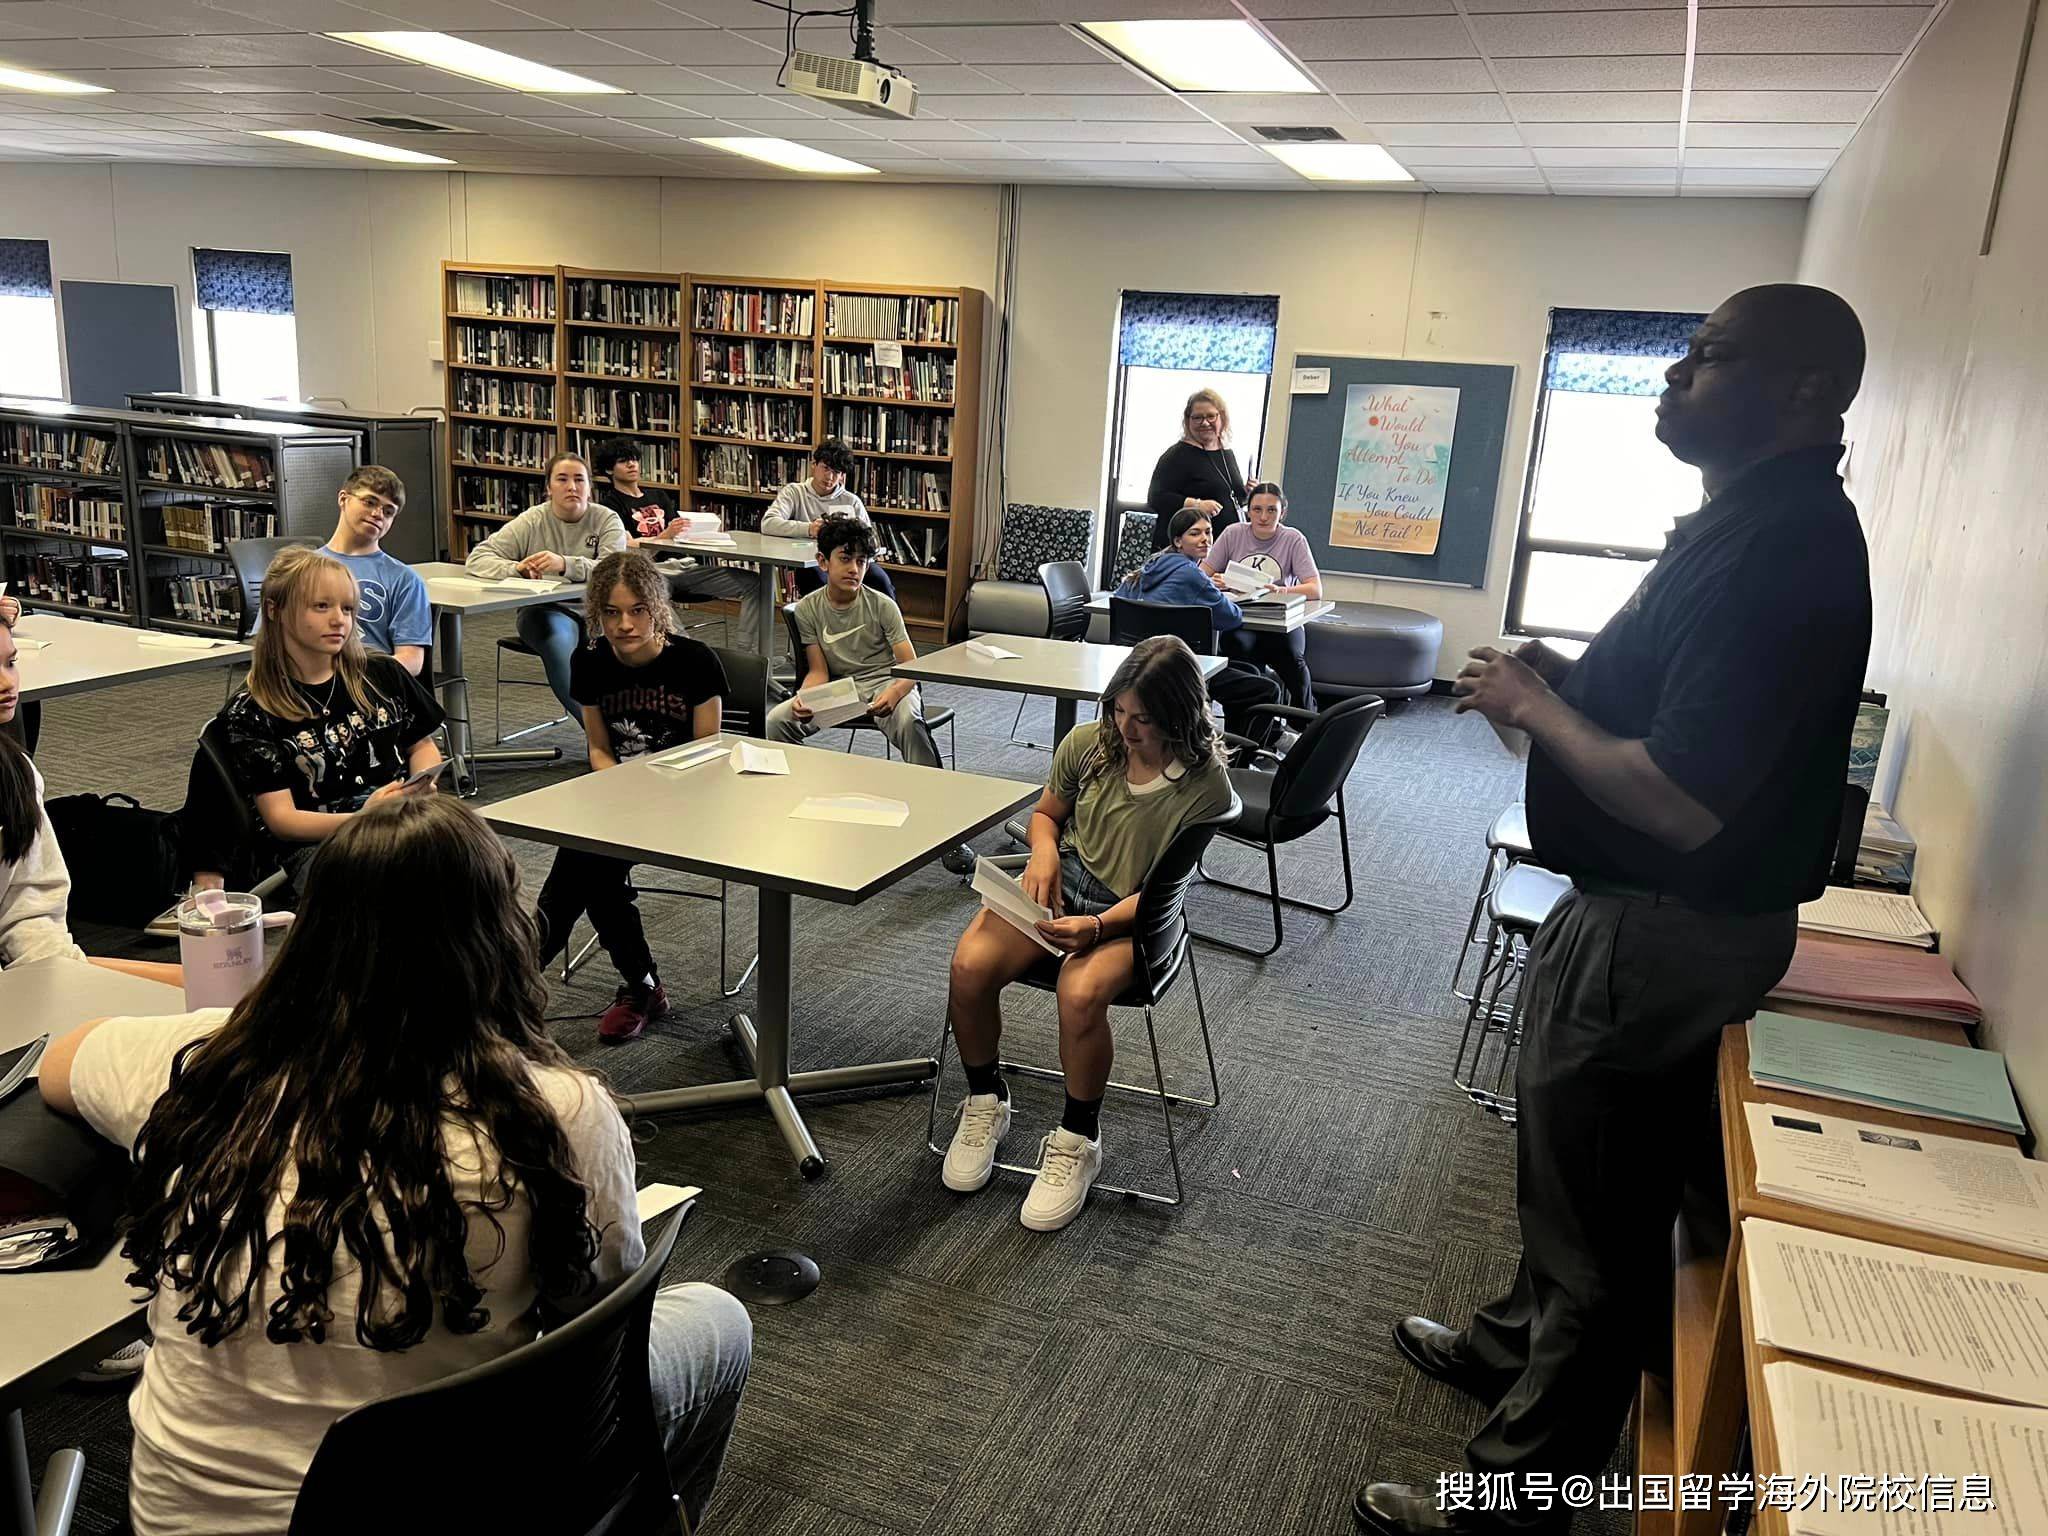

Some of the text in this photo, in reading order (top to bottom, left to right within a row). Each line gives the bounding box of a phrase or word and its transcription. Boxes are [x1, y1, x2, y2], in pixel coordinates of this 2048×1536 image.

[1368, 392, 1408, 413] What
[1380, 415, 1426, 433] Would
[1391, 432, 1421, 453] You
[1345, 445, 1405, 471] Attempt
[1396, 466, 1437, 486] To Do
[1337, 482, 1420, 503] If You Knew
[1364, 501, 1434, 522] You Could
[1353, 519, 1424, 540] Not Fail ?
[356, 578, 387, 623] S
